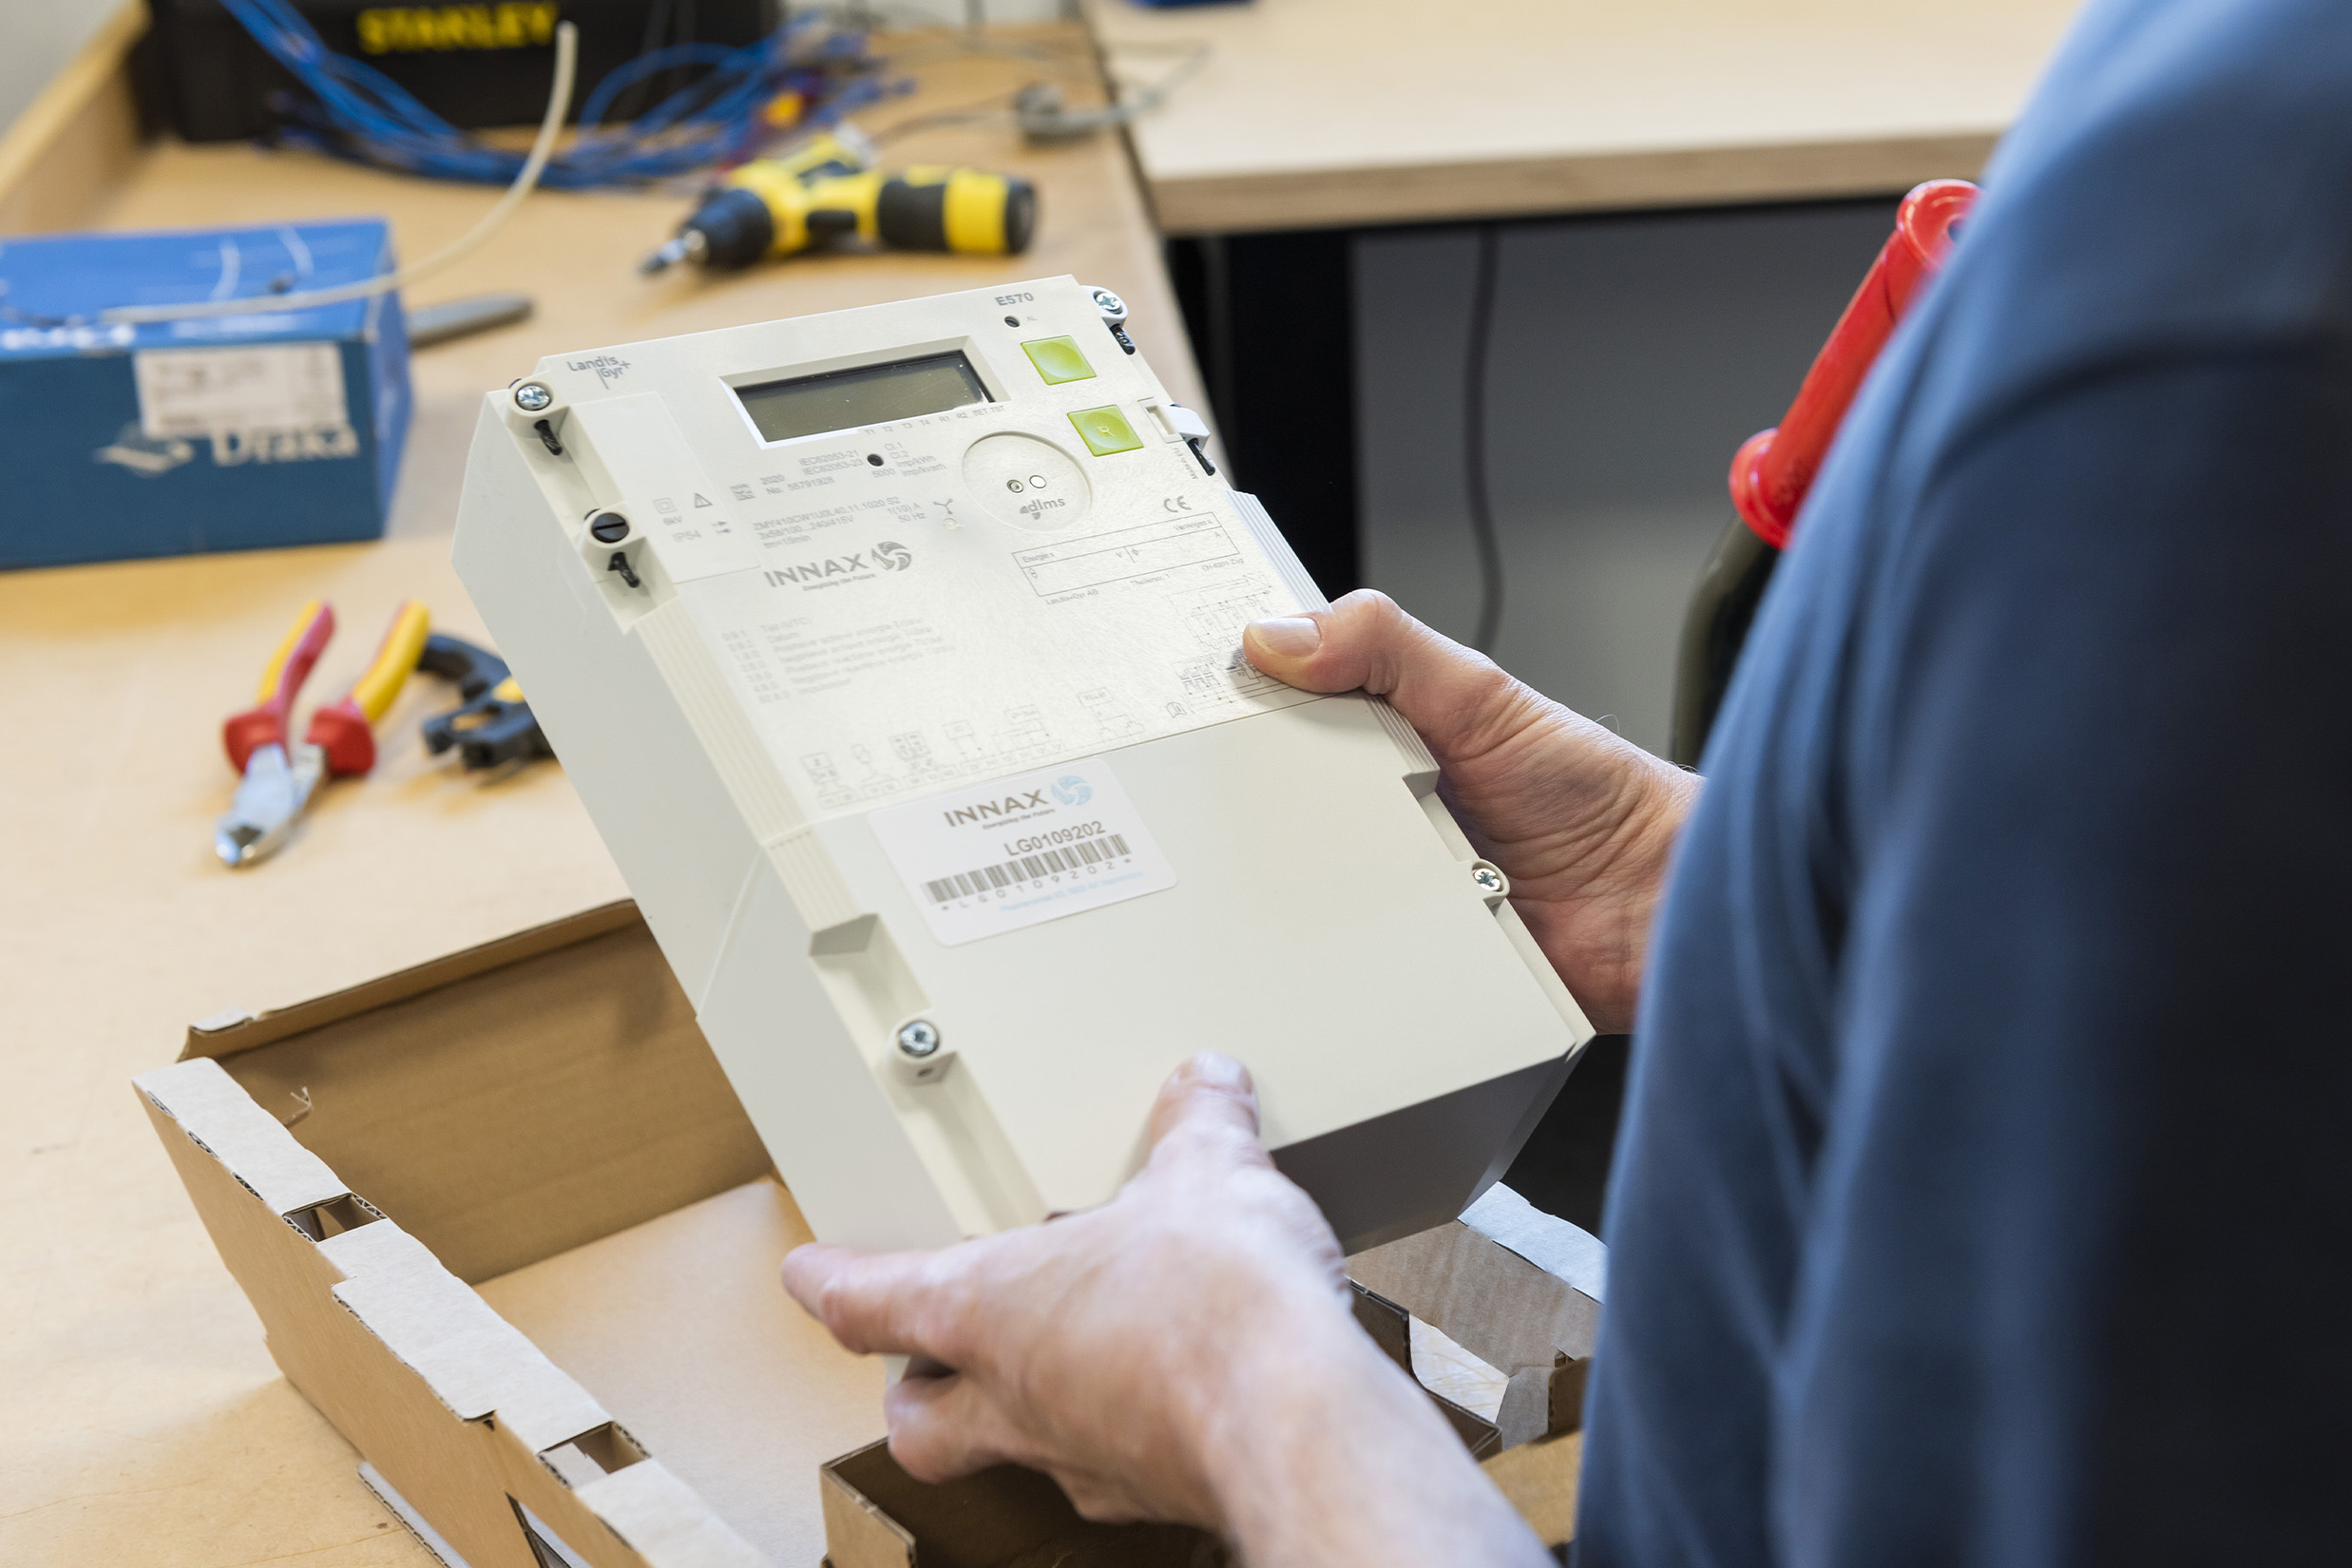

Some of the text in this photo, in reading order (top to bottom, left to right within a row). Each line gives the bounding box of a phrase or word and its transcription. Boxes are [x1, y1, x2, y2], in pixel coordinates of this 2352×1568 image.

[357, 2, 559, 55] STANLEY
[994, 292, 1035, 306] E570
[760, 474, 785, 485] 2020
[871, 468, 896, 478] 5000
[898, 514, 910, 524] 50
[763, 553, 869, 587] INNAX
[943, 789, 1049, 828] INNAX
[1004, 820, 1106, 857] LG0109202
